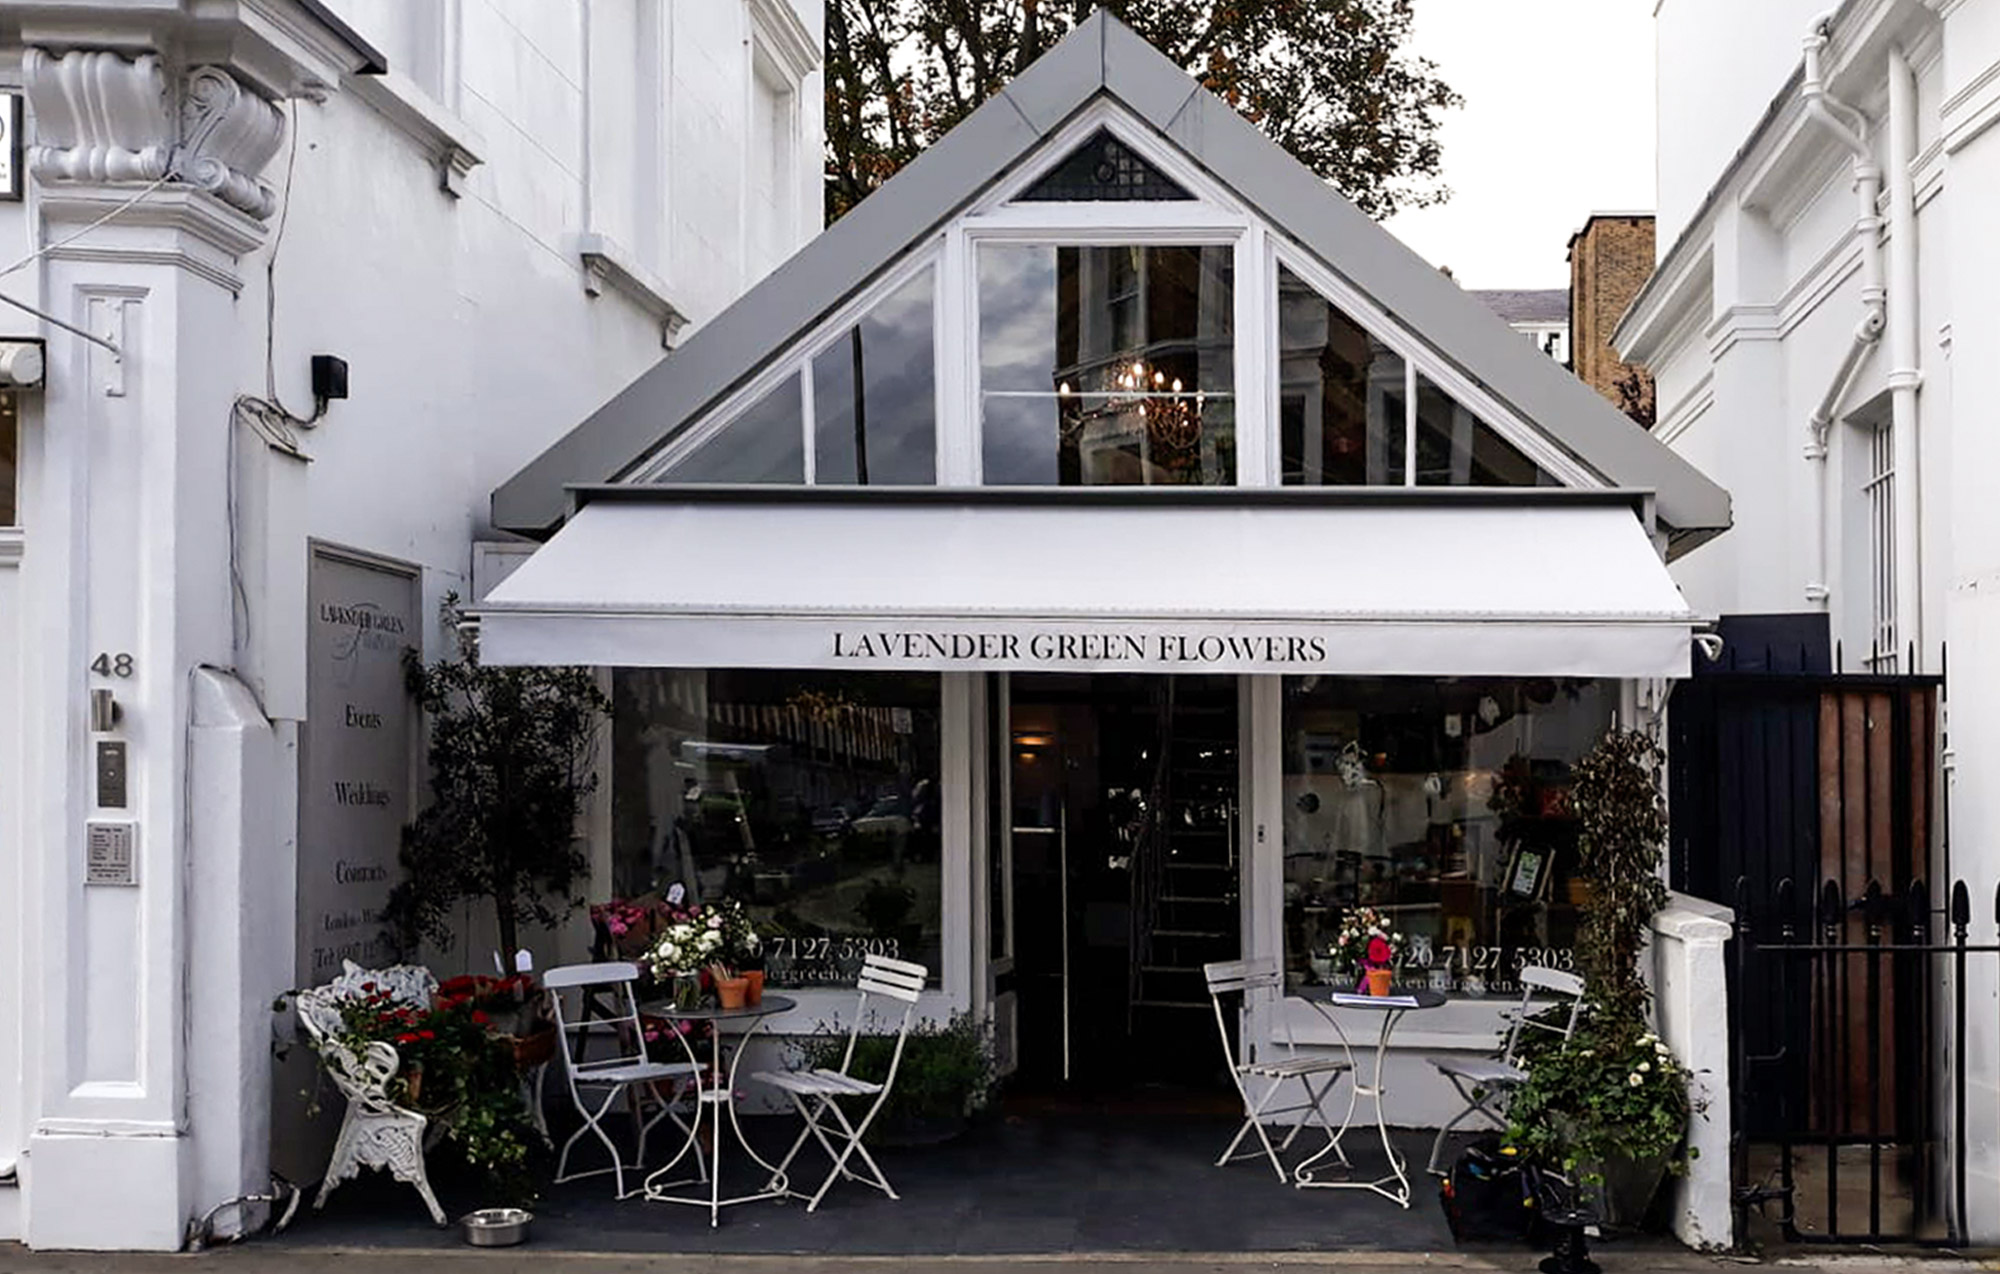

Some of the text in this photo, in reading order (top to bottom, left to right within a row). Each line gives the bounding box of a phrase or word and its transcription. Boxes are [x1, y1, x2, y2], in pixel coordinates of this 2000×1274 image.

[833, 632, 1327, 662] LAVENDER GREEN FLOWERS
[91, 652, 134, 678] 48
[345, 703, 382, 728] Events
[772, 937, 830, 960] 7127
[839, 937, 900, 960] 5303
[1442, 946, 1503, 969] 7127
[1511, 946, 1575, 970] 5303
